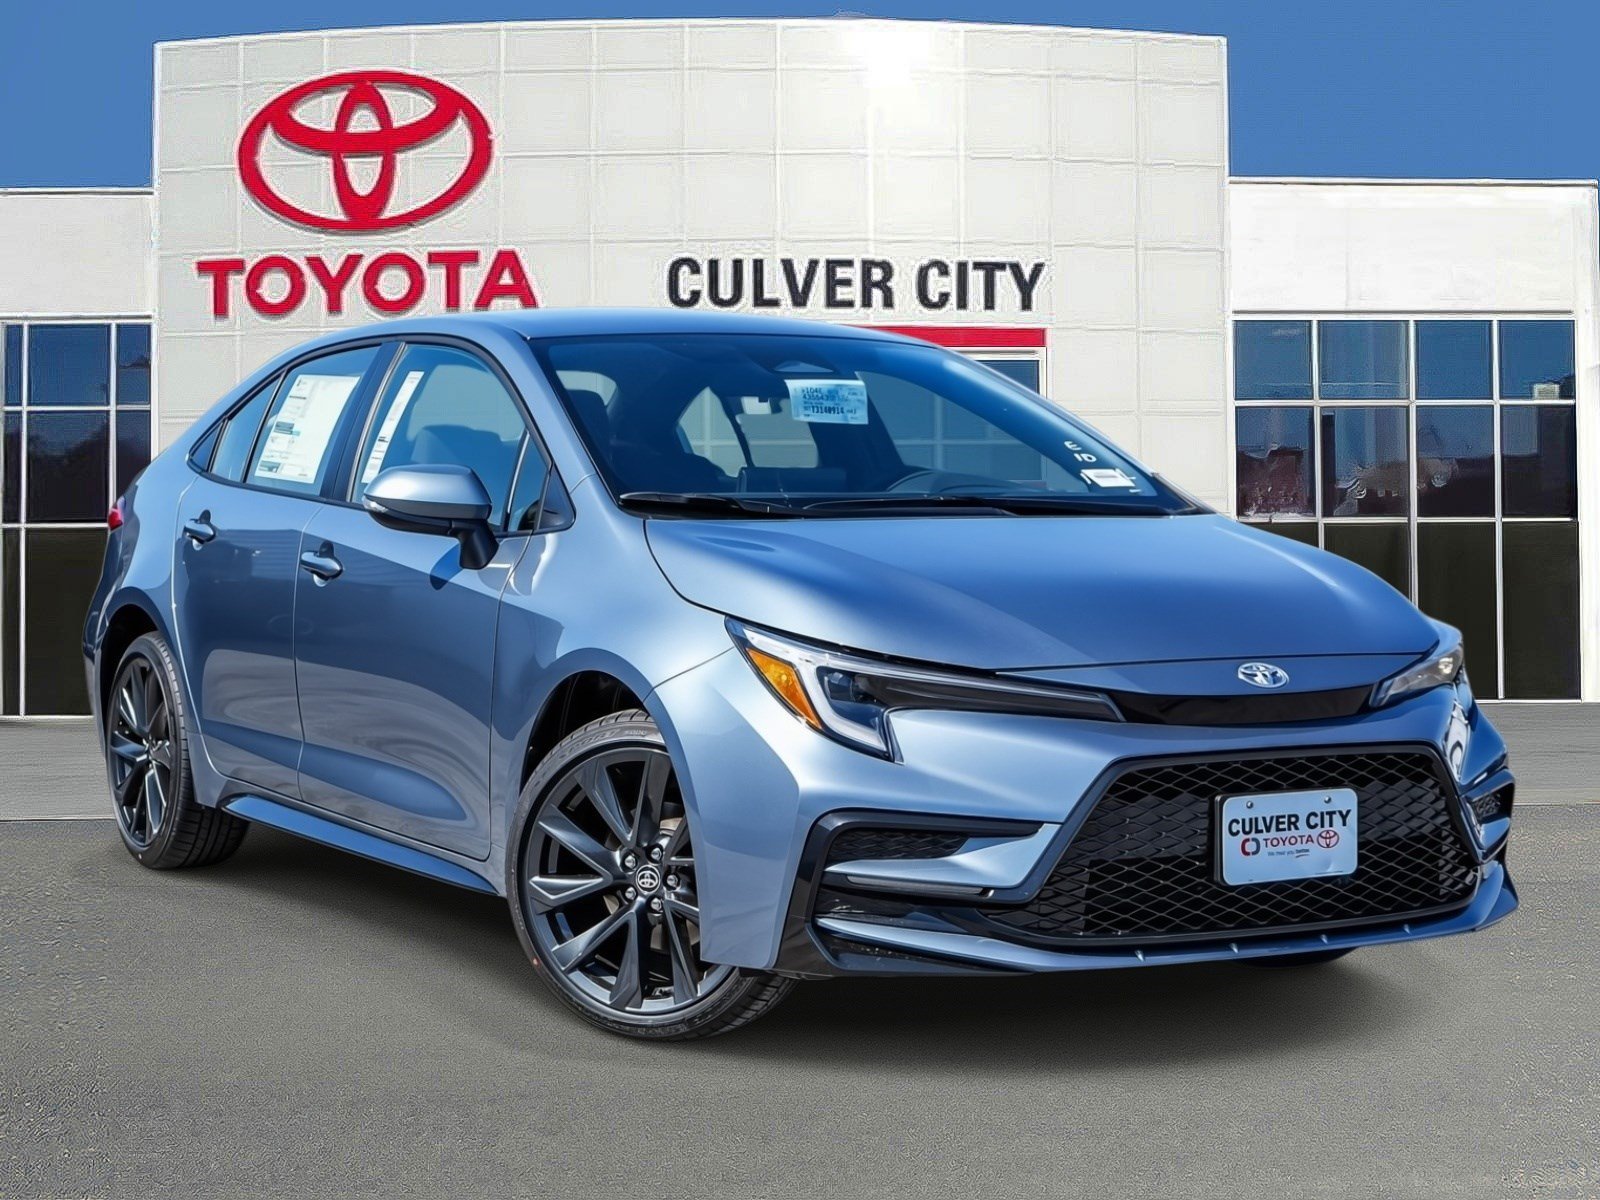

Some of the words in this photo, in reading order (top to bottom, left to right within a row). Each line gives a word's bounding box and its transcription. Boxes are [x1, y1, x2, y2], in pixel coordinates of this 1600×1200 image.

[196, 249, 539, 318] TOYOTA
[666, 257, 895, 309] CULVER
[915, 259, 1046, 311] CITY
[1228, 813, 1300, 837] CULVER
[1305, 809, 1352, 830] CITY
[1263, 834, 1314, 848] TOYOTA
